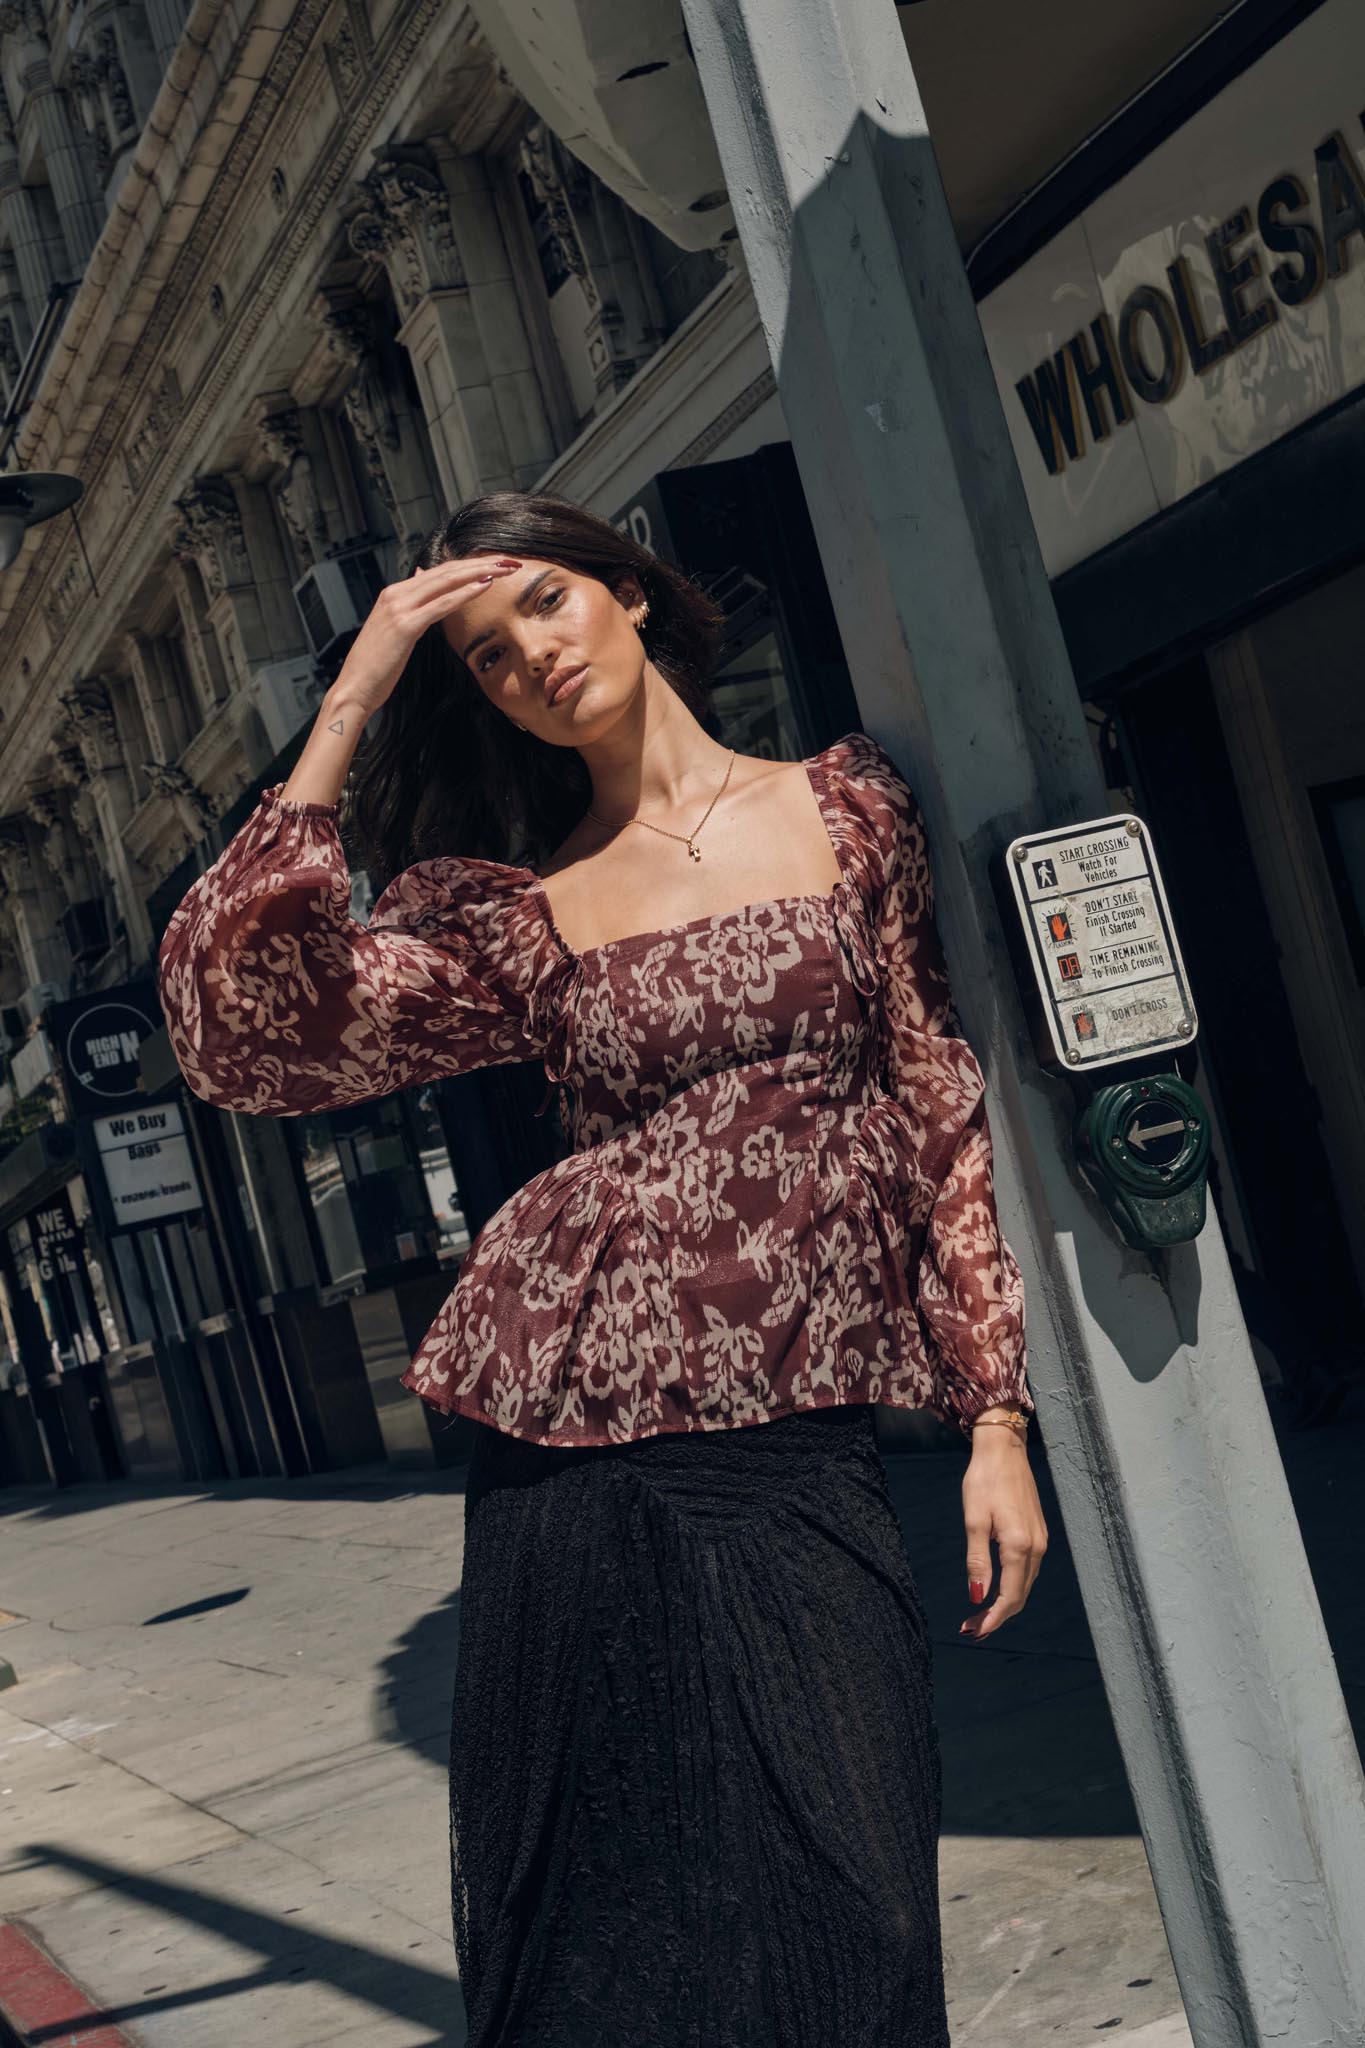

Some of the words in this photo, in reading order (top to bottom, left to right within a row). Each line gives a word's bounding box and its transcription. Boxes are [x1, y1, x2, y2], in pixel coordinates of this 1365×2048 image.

[1014, 110, 1365, 476] WHOLESA
[1059, 846, 1085, 862] START
[1086, 836, 1129, 856] CROSSING
[1078, 858, 1102, 873] Watch
[1104, 855, 1118, 867] For
[1084, 868, 1118, 883] Vehicles
[1085, 896, 1110, 913] DON'T
[1112, 891, 1138, 904] START
[1085, 913, 1110, 928] Finish
[1111, 906, 1146, 922] Crossing
[1099, 925, 1107, 937] If
[1108, 919, 1137, 935] Started
[1089, 951, 1111, 966] TIME
[1112, 940, 1160, 961] REMAINING
[1092, 968, 1103, 979] To
[1104, 961, 1129, 977] Finish
[1131, 954, 1165, 970] Crossing
[1111, 1003, 1138, 1021] DON'T
[1140, 997, 1168, 1014] CROSS
[85, 1033, 121, 1056] HIGH
[92, 1050, 121, 1070] END
[109, 1119, 136, 1137] We
[137, 1112, 167, 1131] Buy
[127, 1142, 162, 1160] Bags
[36, 1207, 67, 1235] WE
